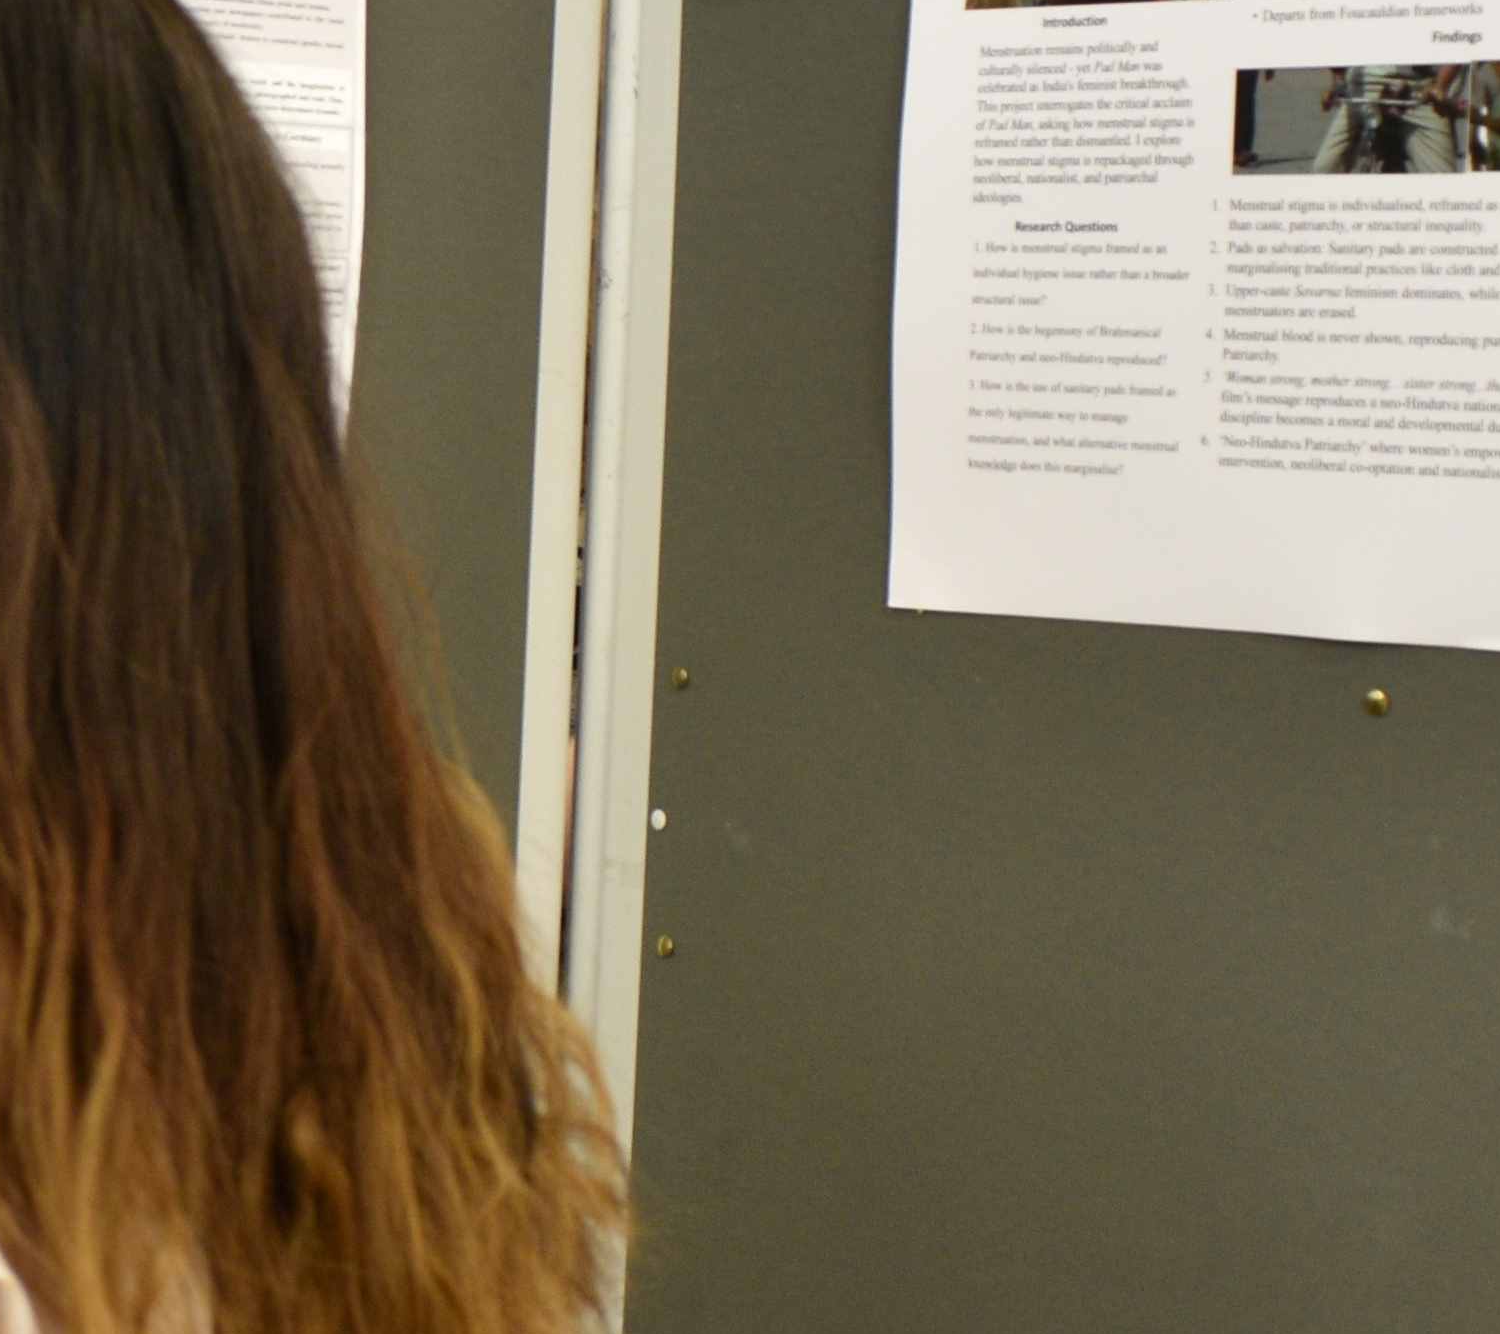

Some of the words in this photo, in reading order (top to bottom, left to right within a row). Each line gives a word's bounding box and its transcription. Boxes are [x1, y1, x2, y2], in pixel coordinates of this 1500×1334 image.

[1042, 17, 1107, 26] Introduction
[1432, 31, 1482, 43] Findings
[1014, 221, 1061, 231] Research
[1064, 221, 1117, 232] Questions
